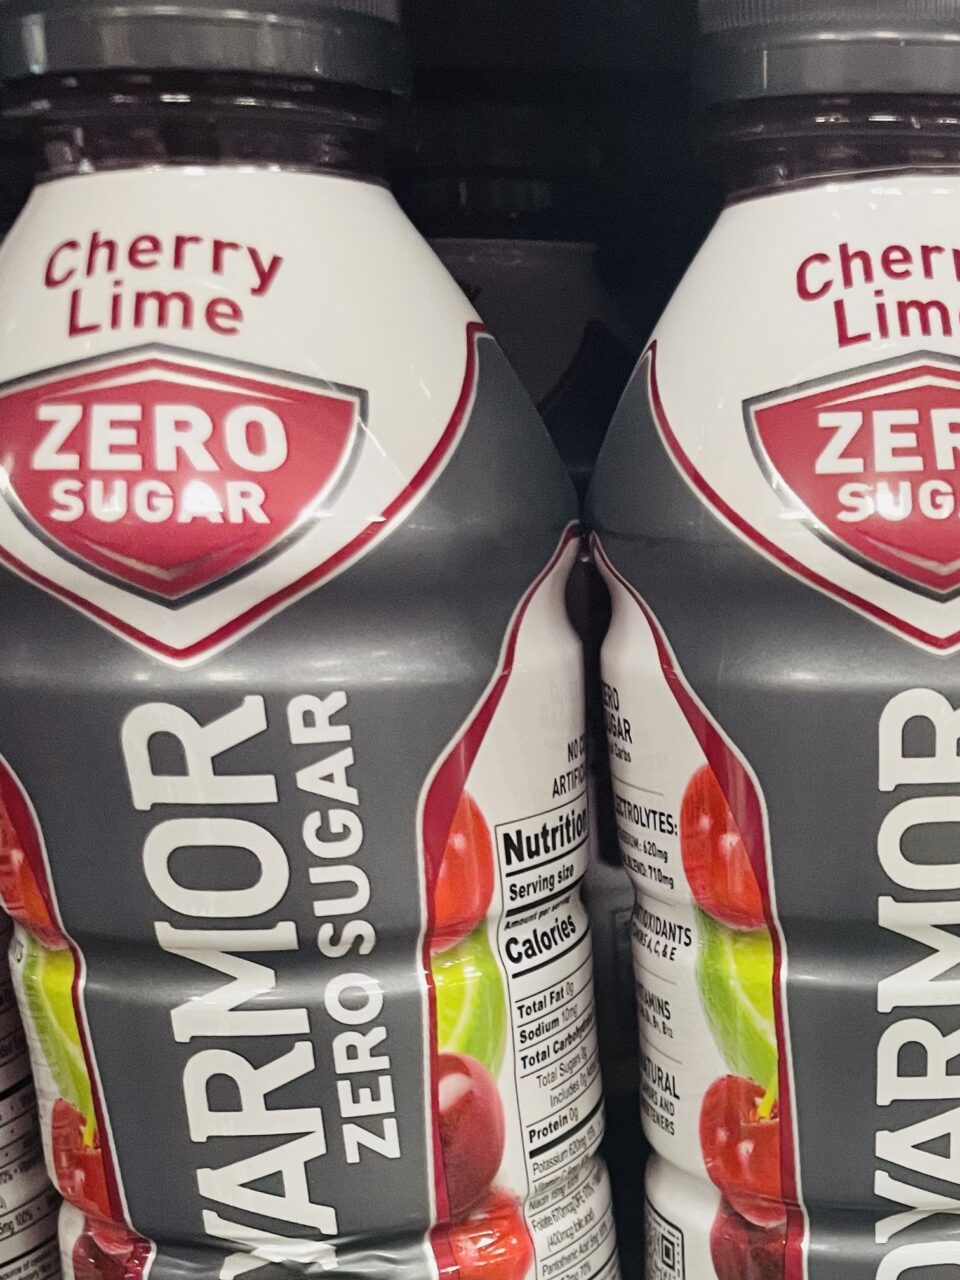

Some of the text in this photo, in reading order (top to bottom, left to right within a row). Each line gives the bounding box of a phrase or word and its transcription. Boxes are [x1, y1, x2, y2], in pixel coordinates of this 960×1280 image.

[44, 231, 283, 295] Cherry
[67, 280, 244, 337] Lime
[31, 404, 289, 472] ZERO
[50, 479, 271, 524] SUGAR
[503, 807, 587, 865] Nutrition
[509, 863, 574, 901] Serving size
[286, 690, 401, 1165] ZERO SUGAR
[505, 914, 576, 964] Calories
[517, 995, 547, 1019] Total
[549, 986, 565, 1008] Fat
[519, 1016, 560, 1044] Sodium
[521, 1046, 550, 1070] Total
[536, 1066, 558, 1089] Total
[550, 1079, 580, 1107] Includes
[529, 1115, 568, 1144] Protein
[532, 1147, 568, 1176] Potassium
